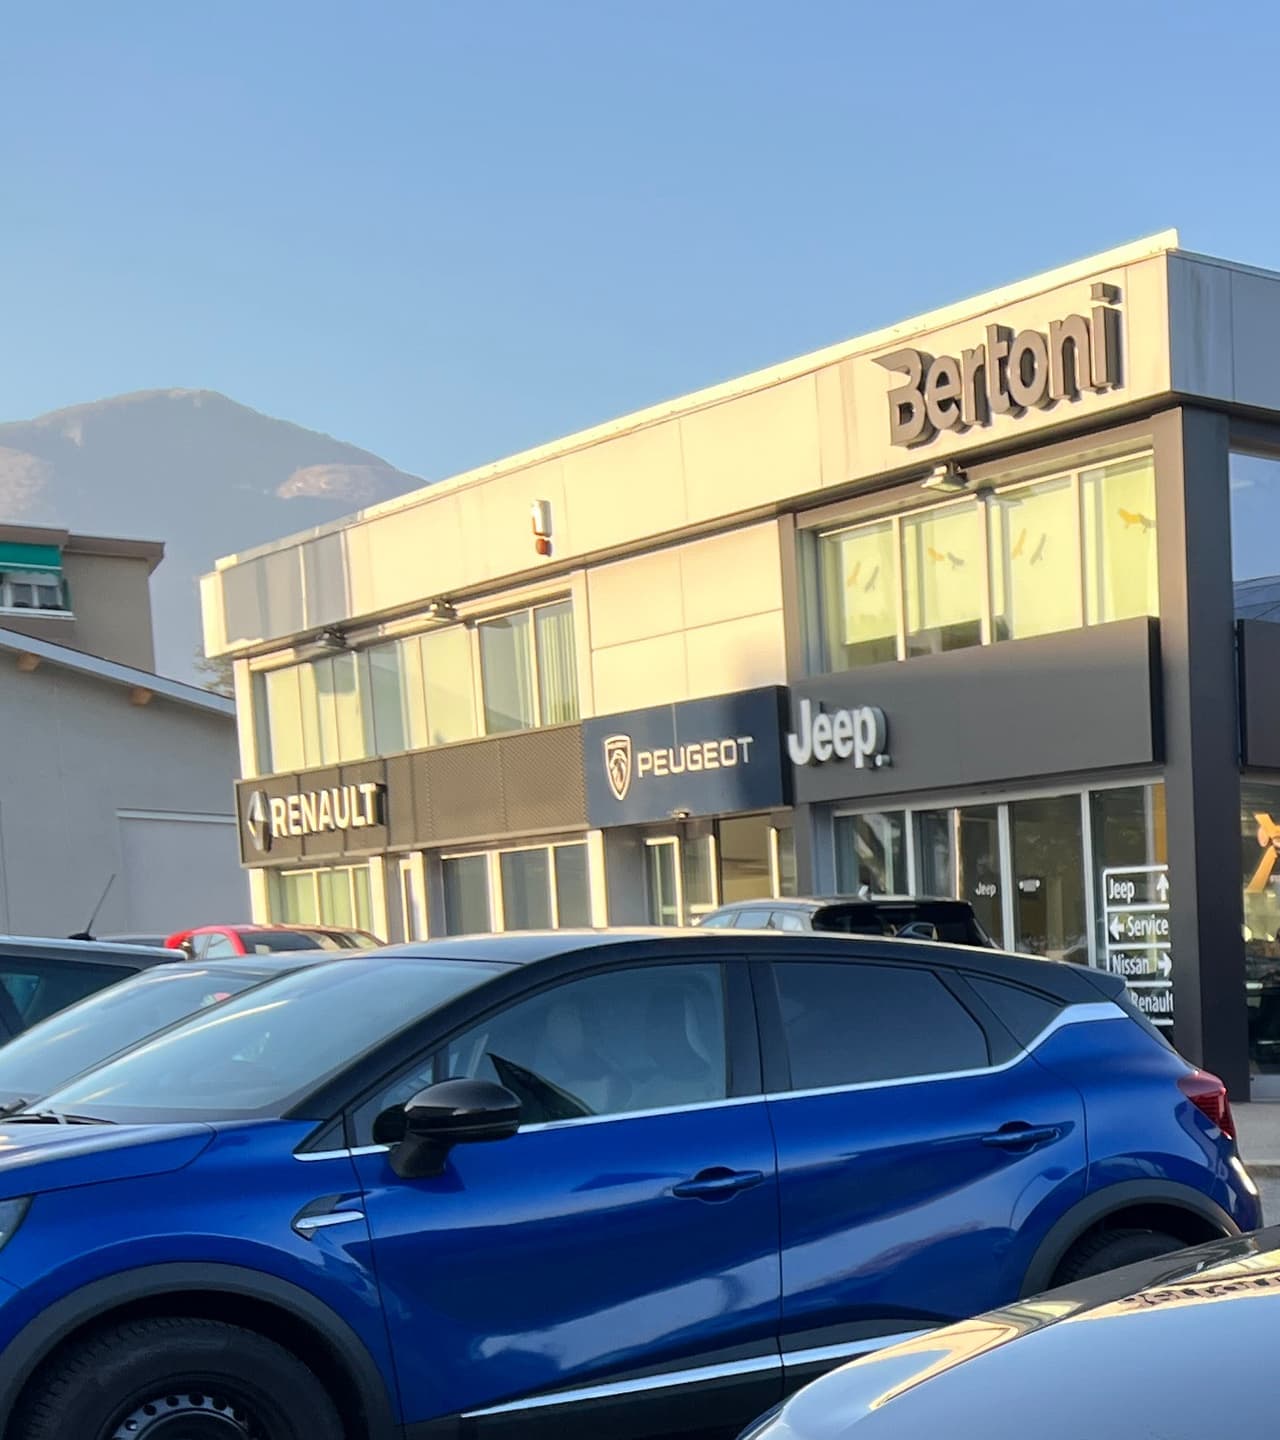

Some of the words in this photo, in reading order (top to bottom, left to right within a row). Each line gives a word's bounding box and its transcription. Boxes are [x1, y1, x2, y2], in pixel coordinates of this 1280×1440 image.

[872, 282, 1123, 447] Bertoni
[788, 699, 879, 768] Jeep
[637, 736, 753, 778] PEUGEOT
[270, 782, 382, 838] RENAULT
[975, 881, 996, 898] Jeep
[1108, 878, 1135, 903] Jeep
[1127, 914, 1169, 937] Service
[1112, 954, 1150, 975] Nissan
